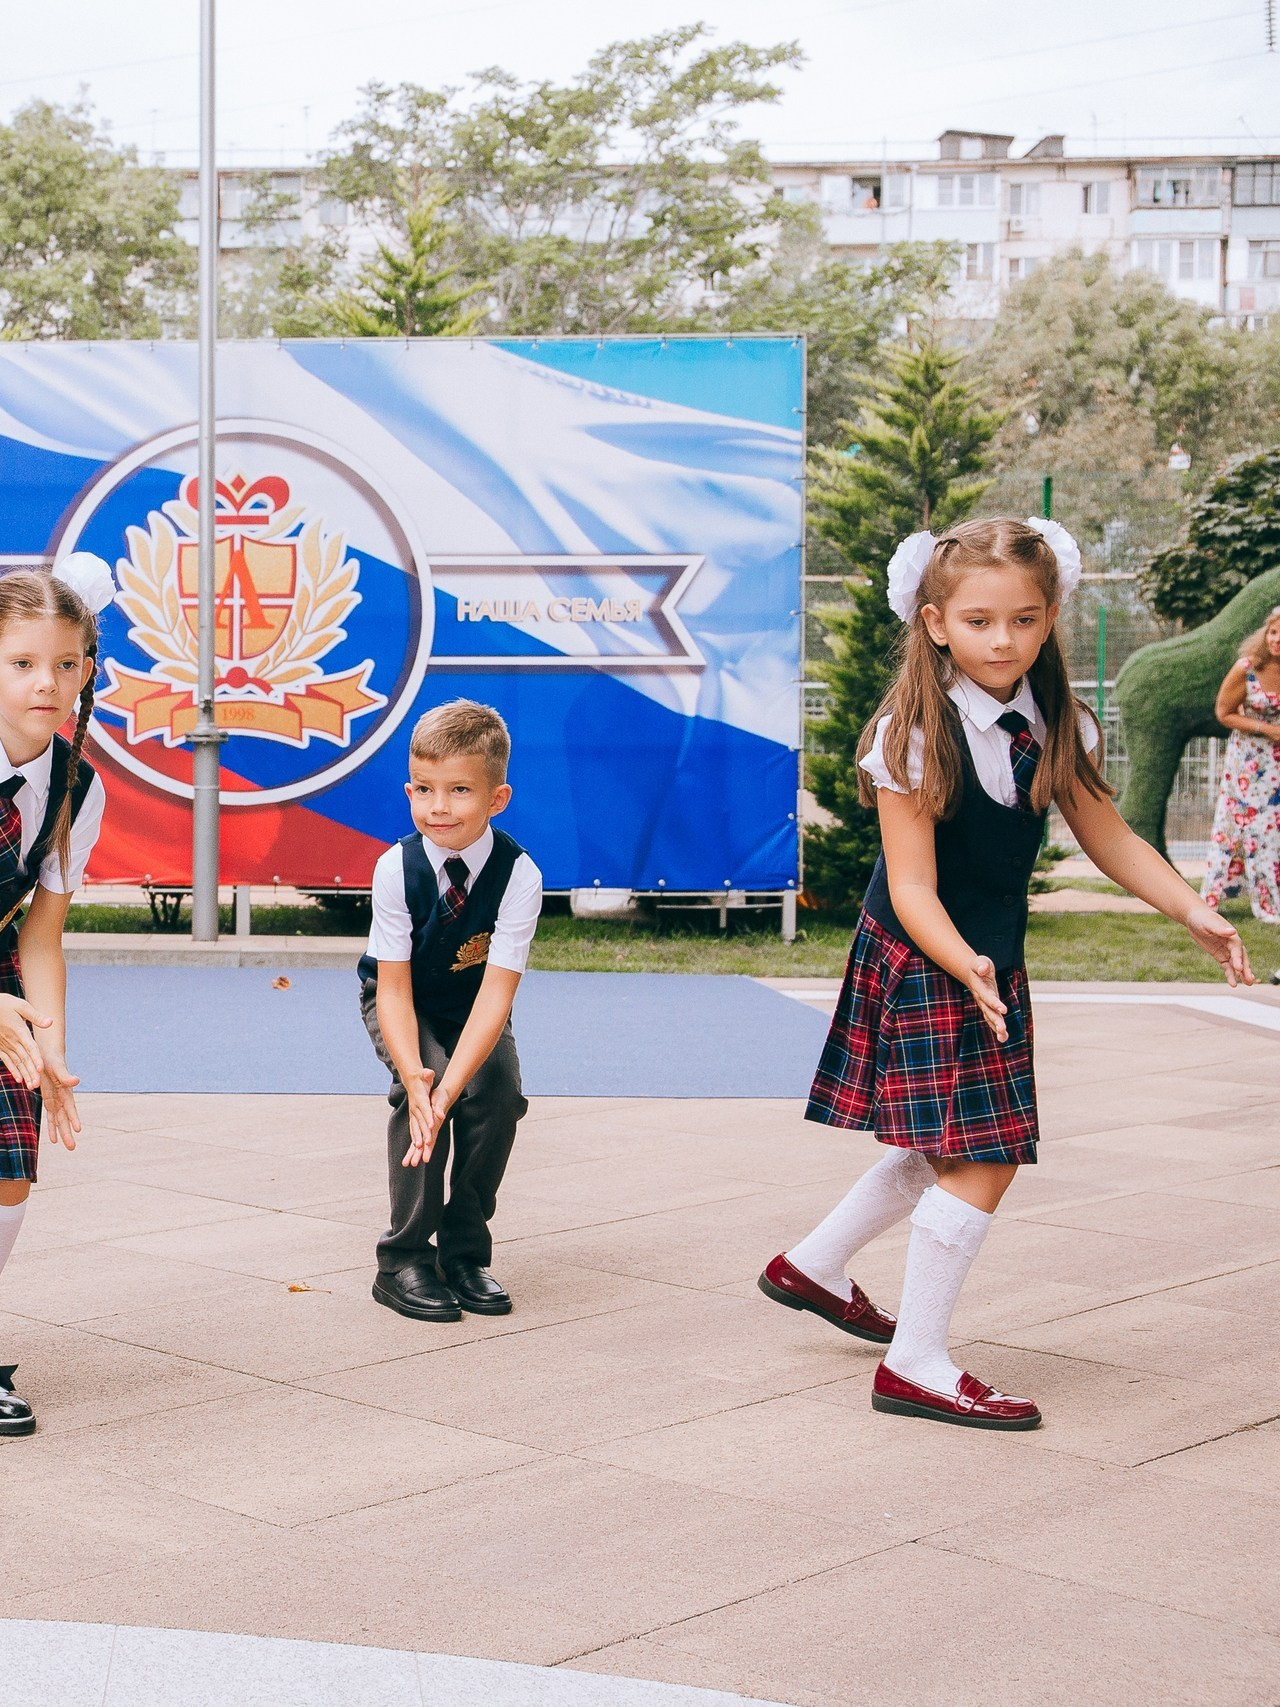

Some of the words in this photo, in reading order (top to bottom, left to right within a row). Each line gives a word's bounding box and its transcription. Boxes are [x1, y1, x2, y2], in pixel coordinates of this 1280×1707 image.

[457, 598, 541, 622] НАША
[548, 597, 642, 622] СЕМЬЯ
[222, 707, 256, 721] 1998
